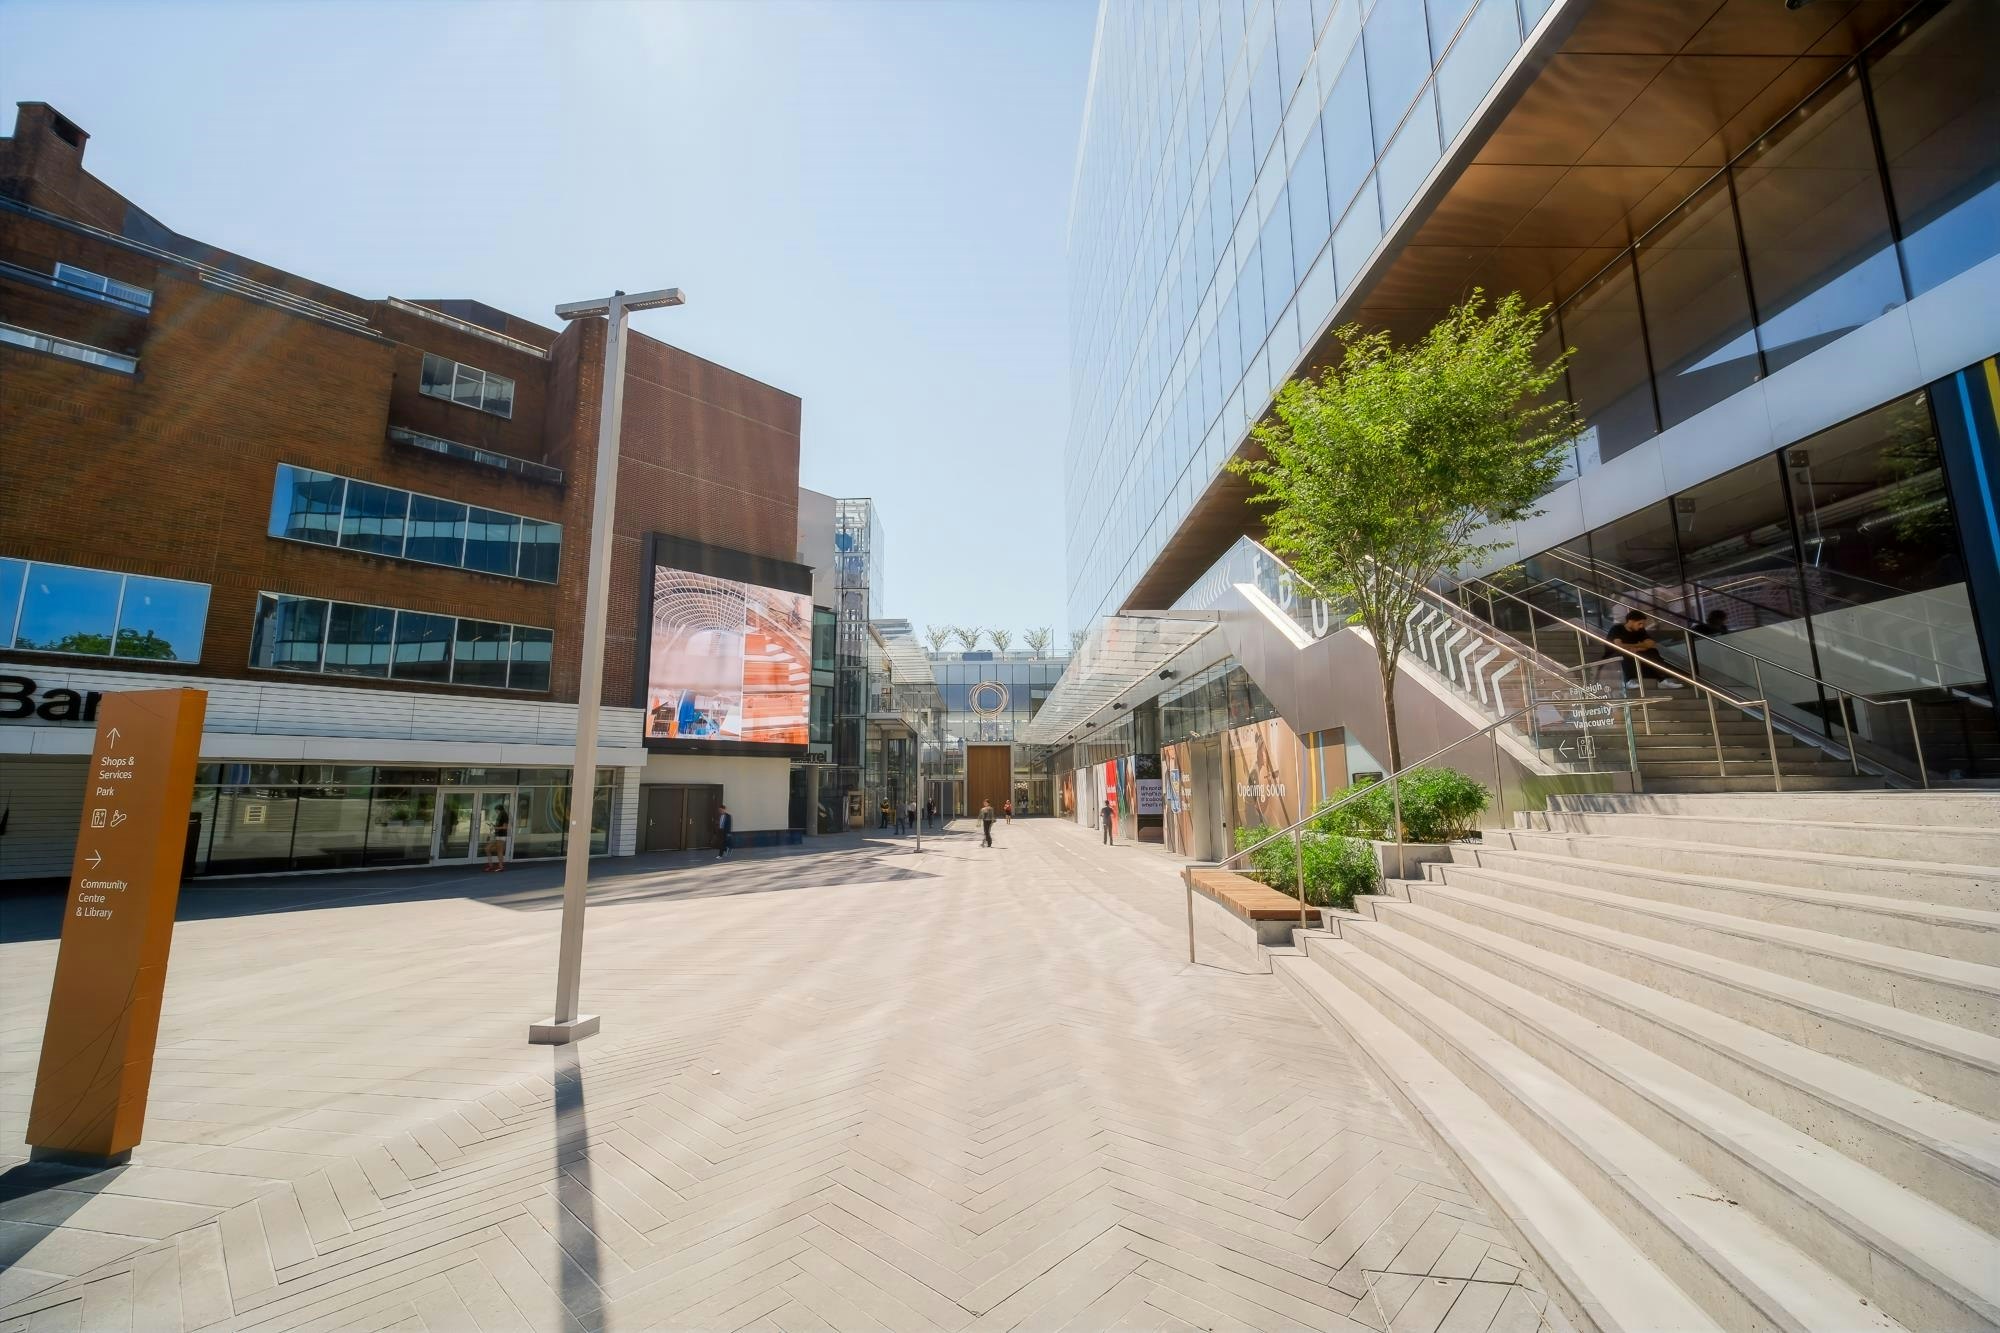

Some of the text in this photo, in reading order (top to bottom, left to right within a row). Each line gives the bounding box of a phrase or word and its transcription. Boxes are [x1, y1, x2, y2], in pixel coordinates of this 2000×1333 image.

[1574, 717, 1615, 729] Vancouver
[101, 756, 135, 768] Shops &
[99, 770, 132, 780] Services
[96, 786, 115, 796] Park
[1237, 780, 1286, 803] Opening soon
[80, 878, 128, 892] Community
[78, 892, 106, 903] Centre
[75, 906, 113, 920] & Library
